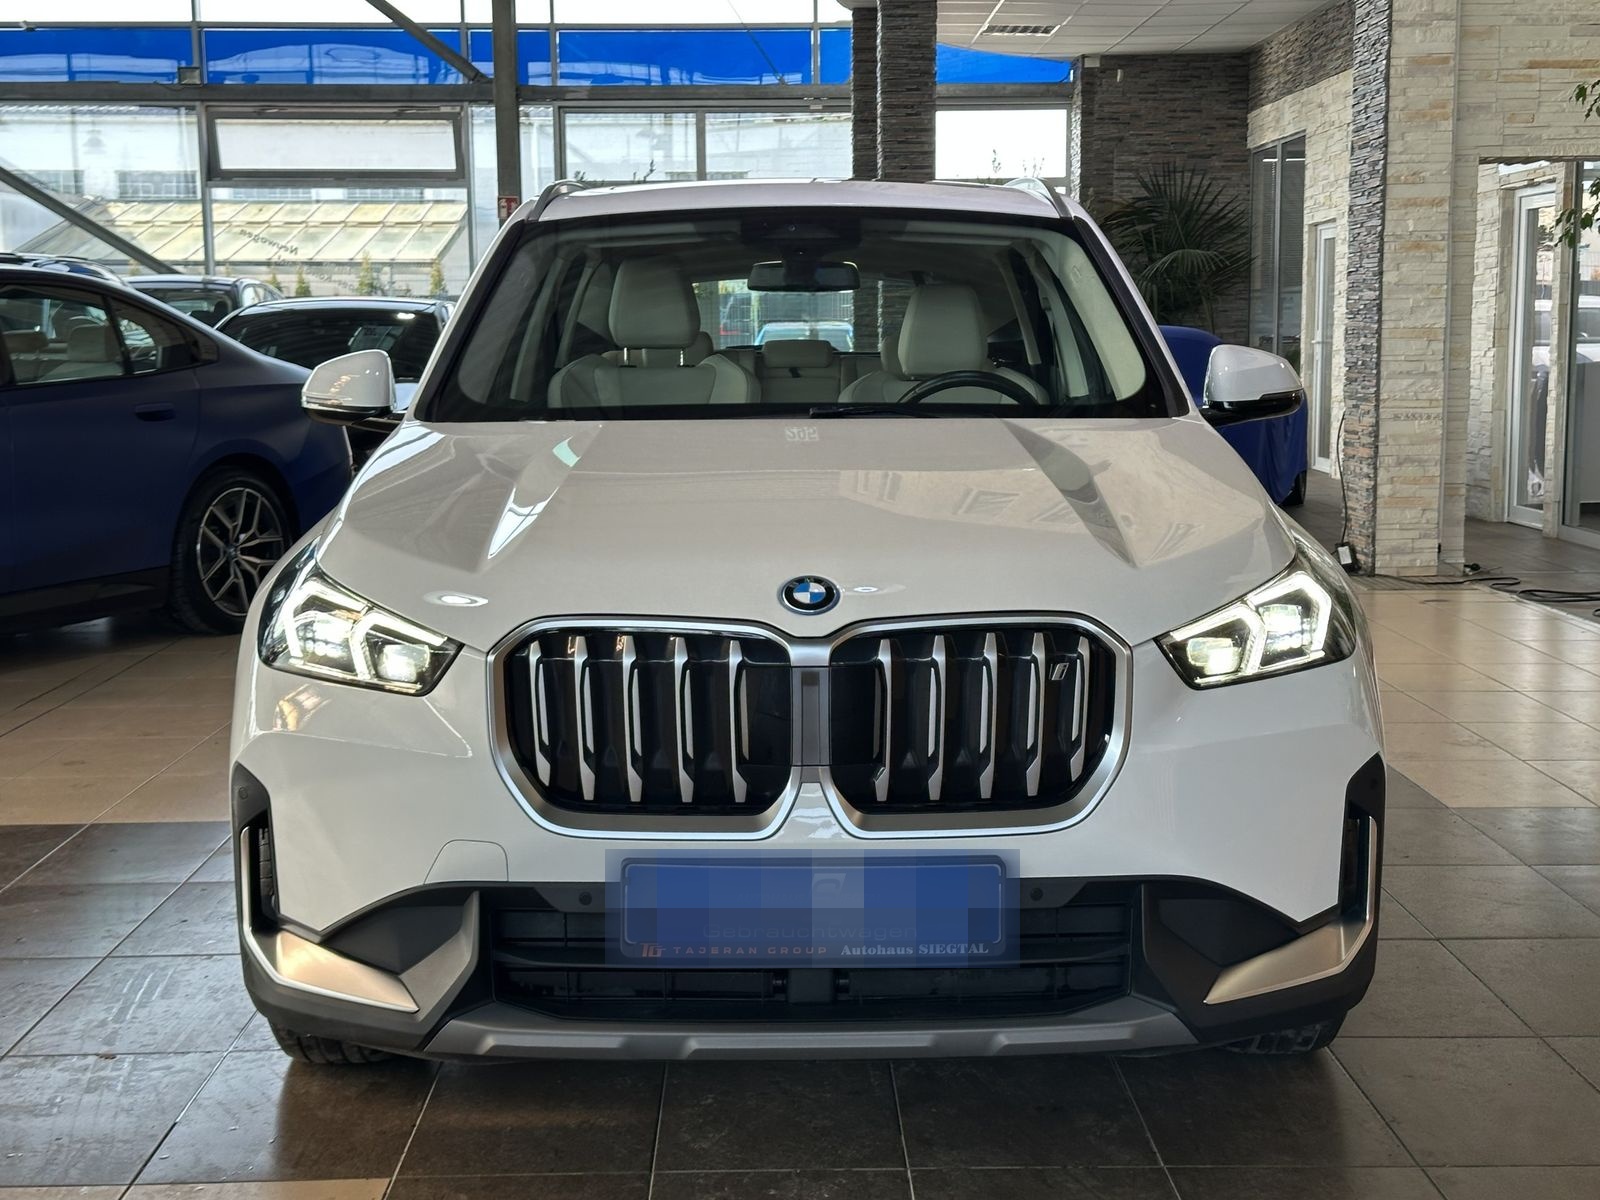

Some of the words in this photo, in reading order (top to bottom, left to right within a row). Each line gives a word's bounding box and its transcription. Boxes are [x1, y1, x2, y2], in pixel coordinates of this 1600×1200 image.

[703, 923, 918, 941] Gebrauchtwagen
[673, 946, 757, 954] TAJERAN
[767, 946, 827, 954] GROUP
[841, 944, 914, 956] Autohaus
[918, 943, 989, 954] SIEGTAL
